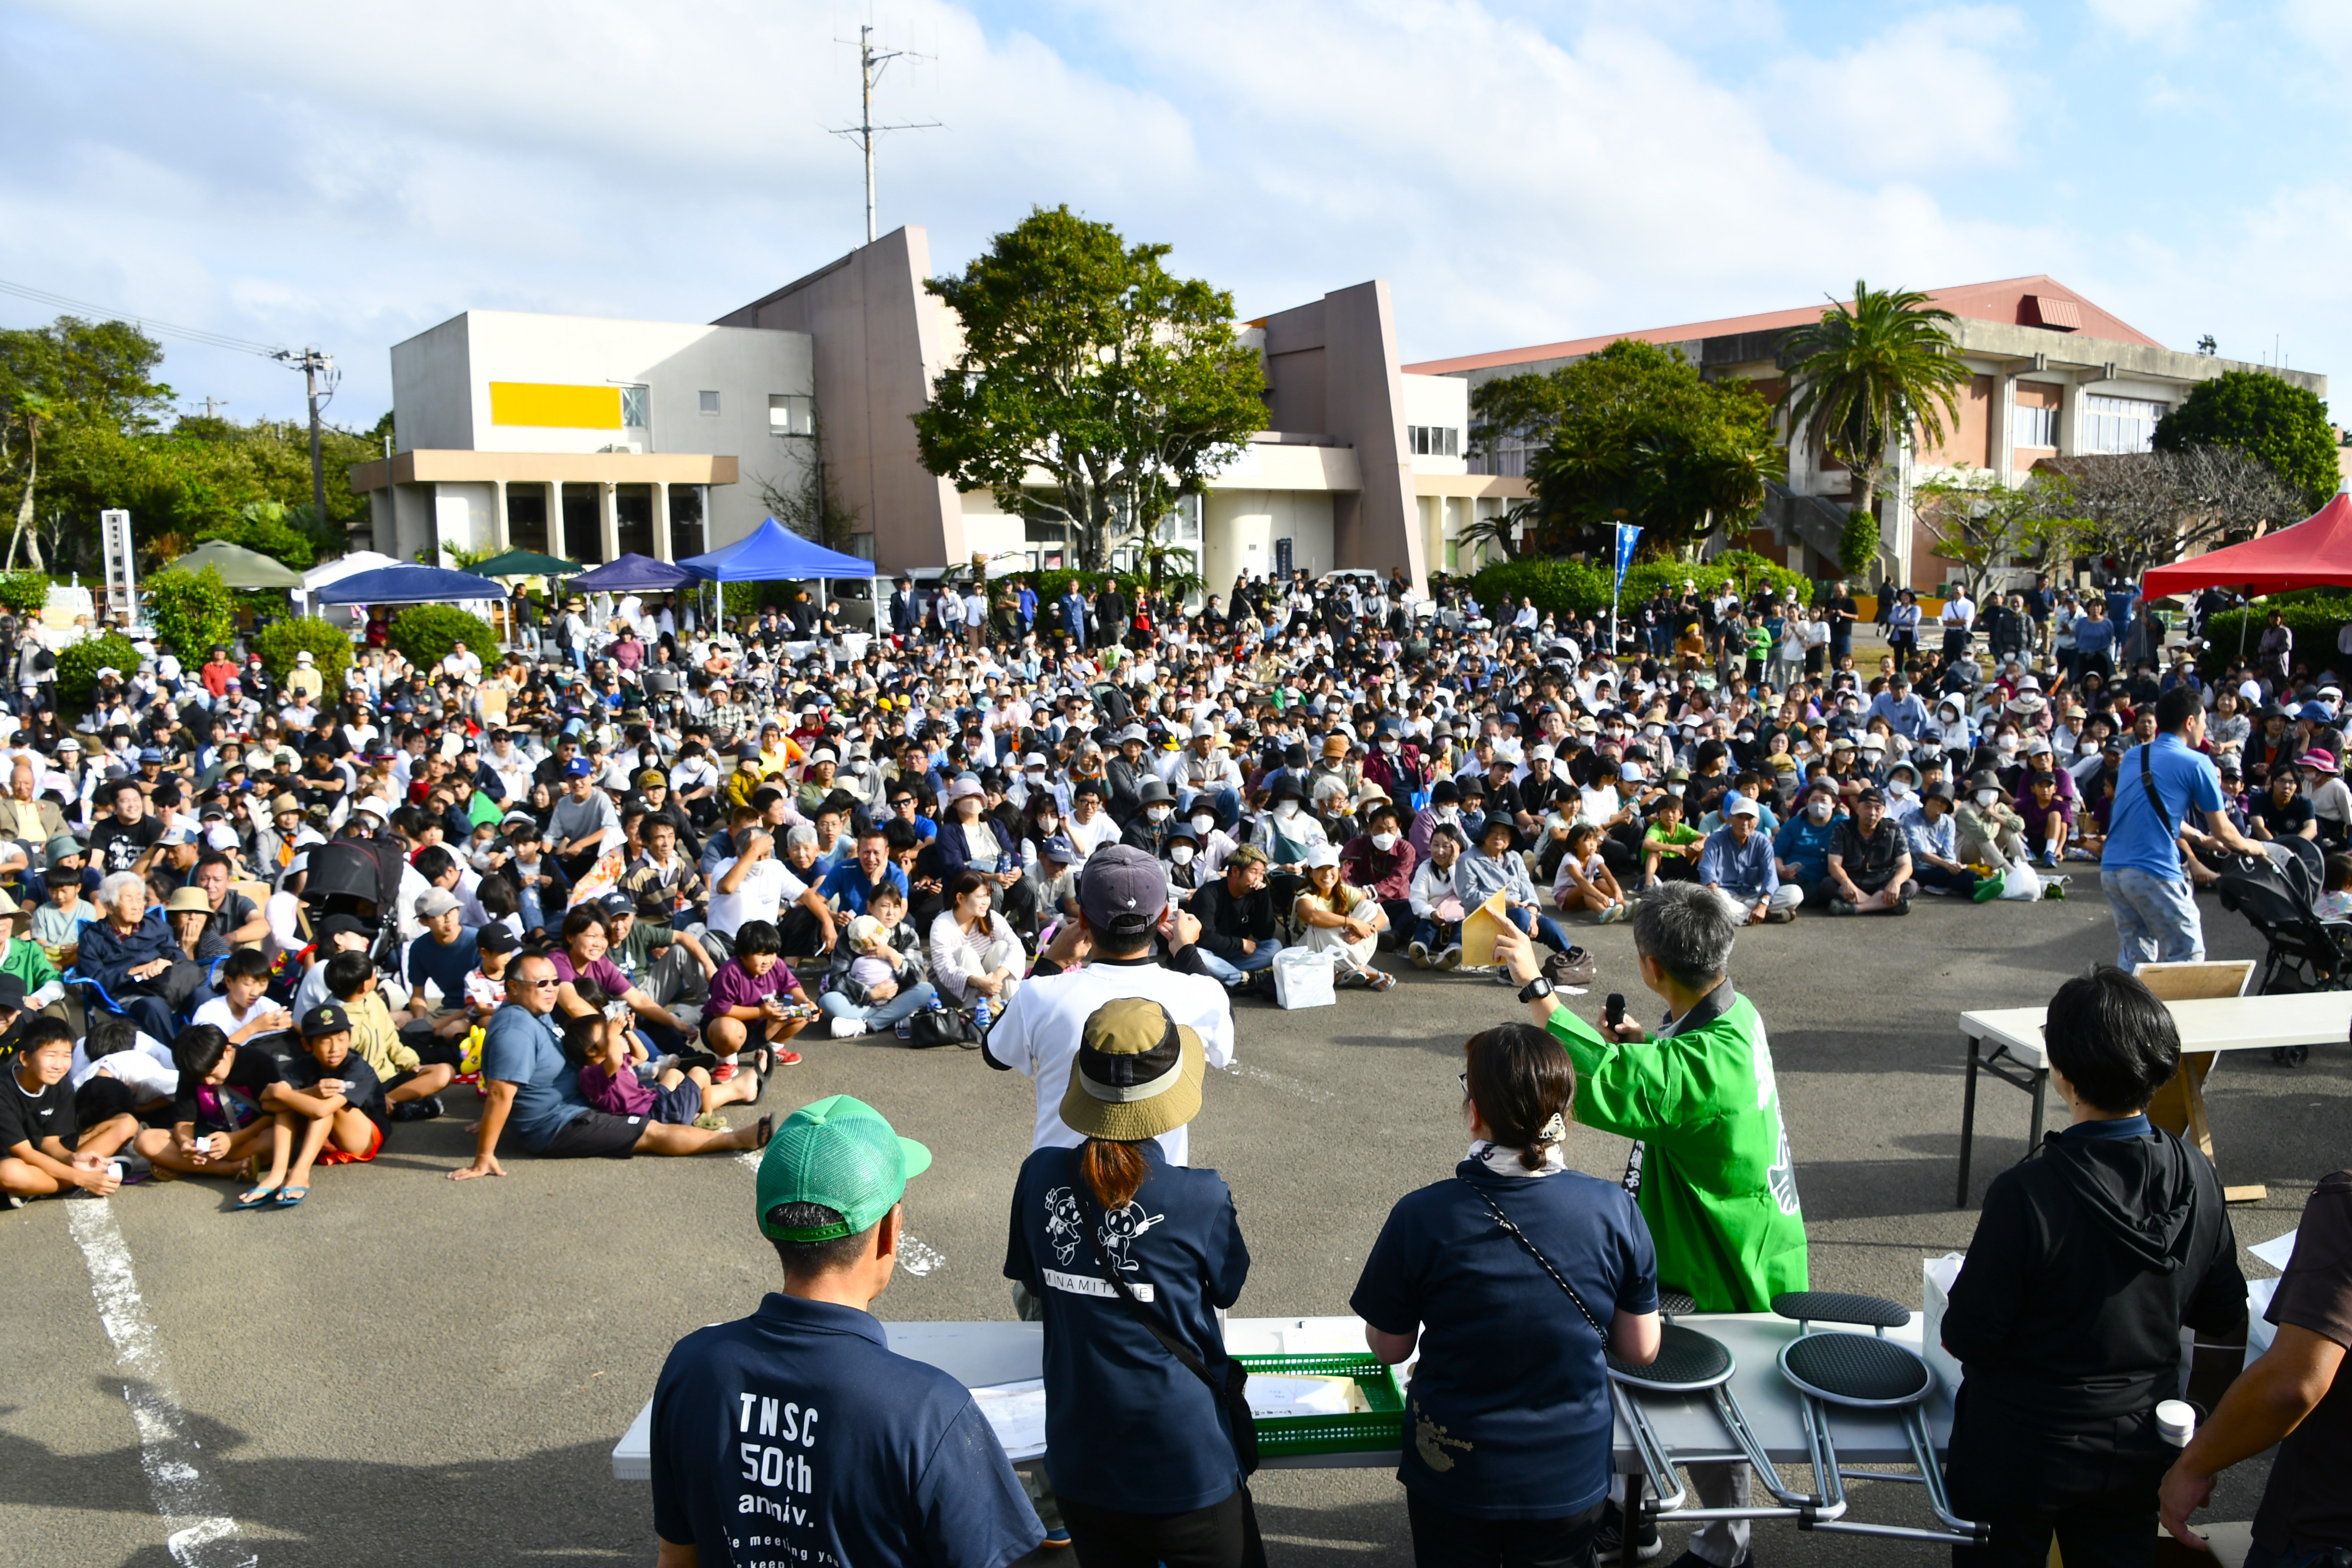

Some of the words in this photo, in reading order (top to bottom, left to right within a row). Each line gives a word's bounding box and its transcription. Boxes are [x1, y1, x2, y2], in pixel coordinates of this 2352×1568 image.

[1043, 1271, 1149, 1298] MINAMITE
[740, 1392, 818, 1448] TNSC
[740, 1442, 812, 1494] 50th
[738, 1492, 814, 1528] anniv.
[749, 1535, 808, 1561] meeting
